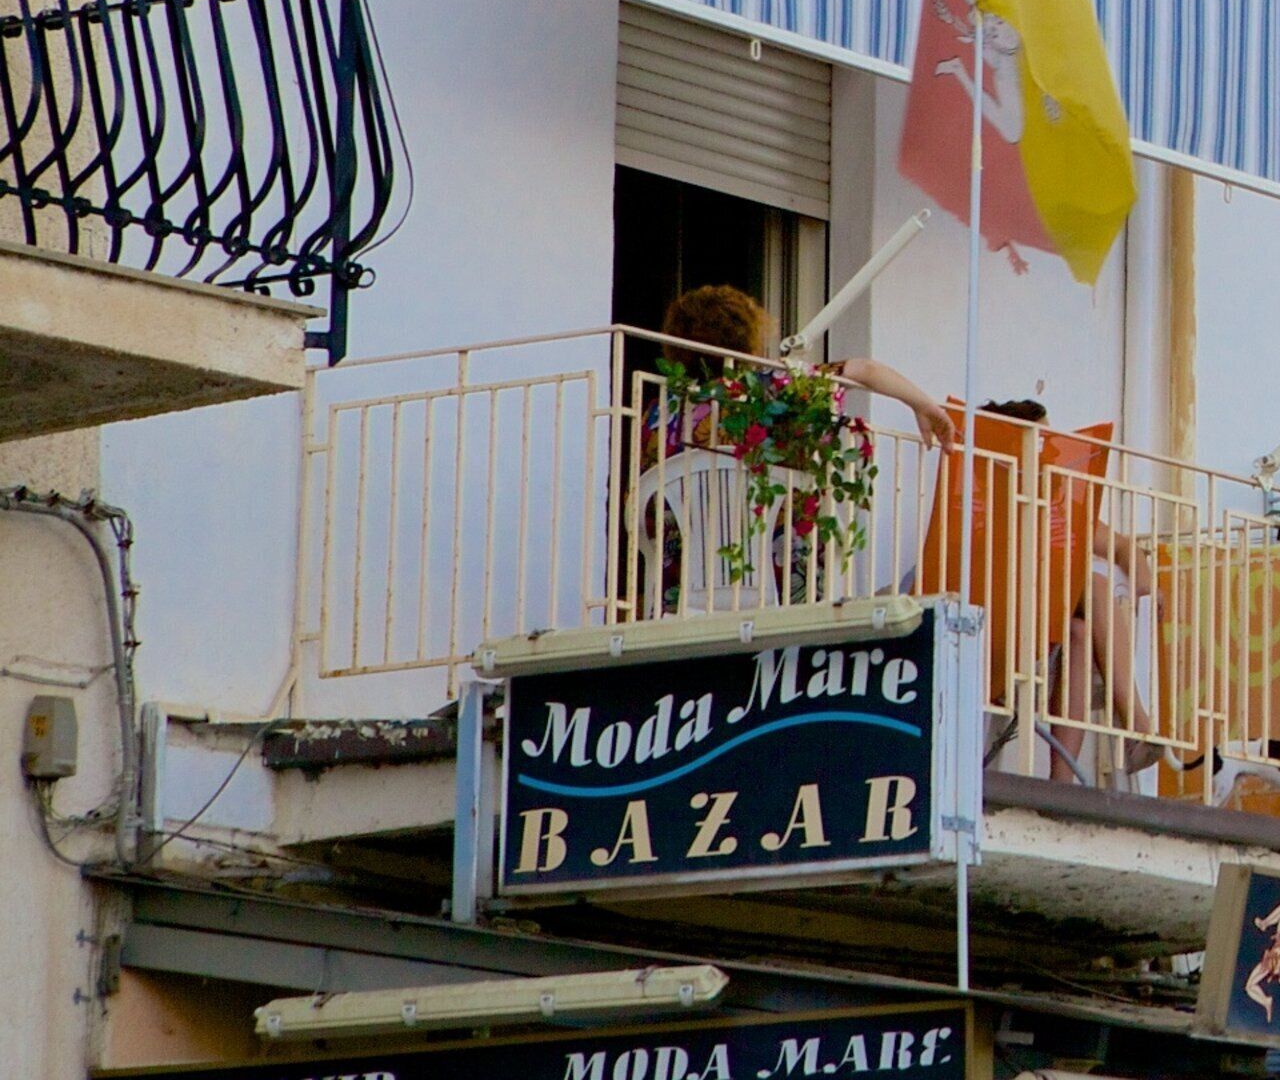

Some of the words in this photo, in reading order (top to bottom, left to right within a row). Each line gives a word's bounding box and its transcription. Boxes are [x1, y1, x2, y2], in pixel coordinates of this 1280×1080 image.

[521, 691, 714, 769] Moda
[726, 644, 920, 725] Mare
[513, 774, 919, 874] BAZAR
[563, 1043, 731, 1080] MODA
[756, 1026, 953, 1077] MARE
